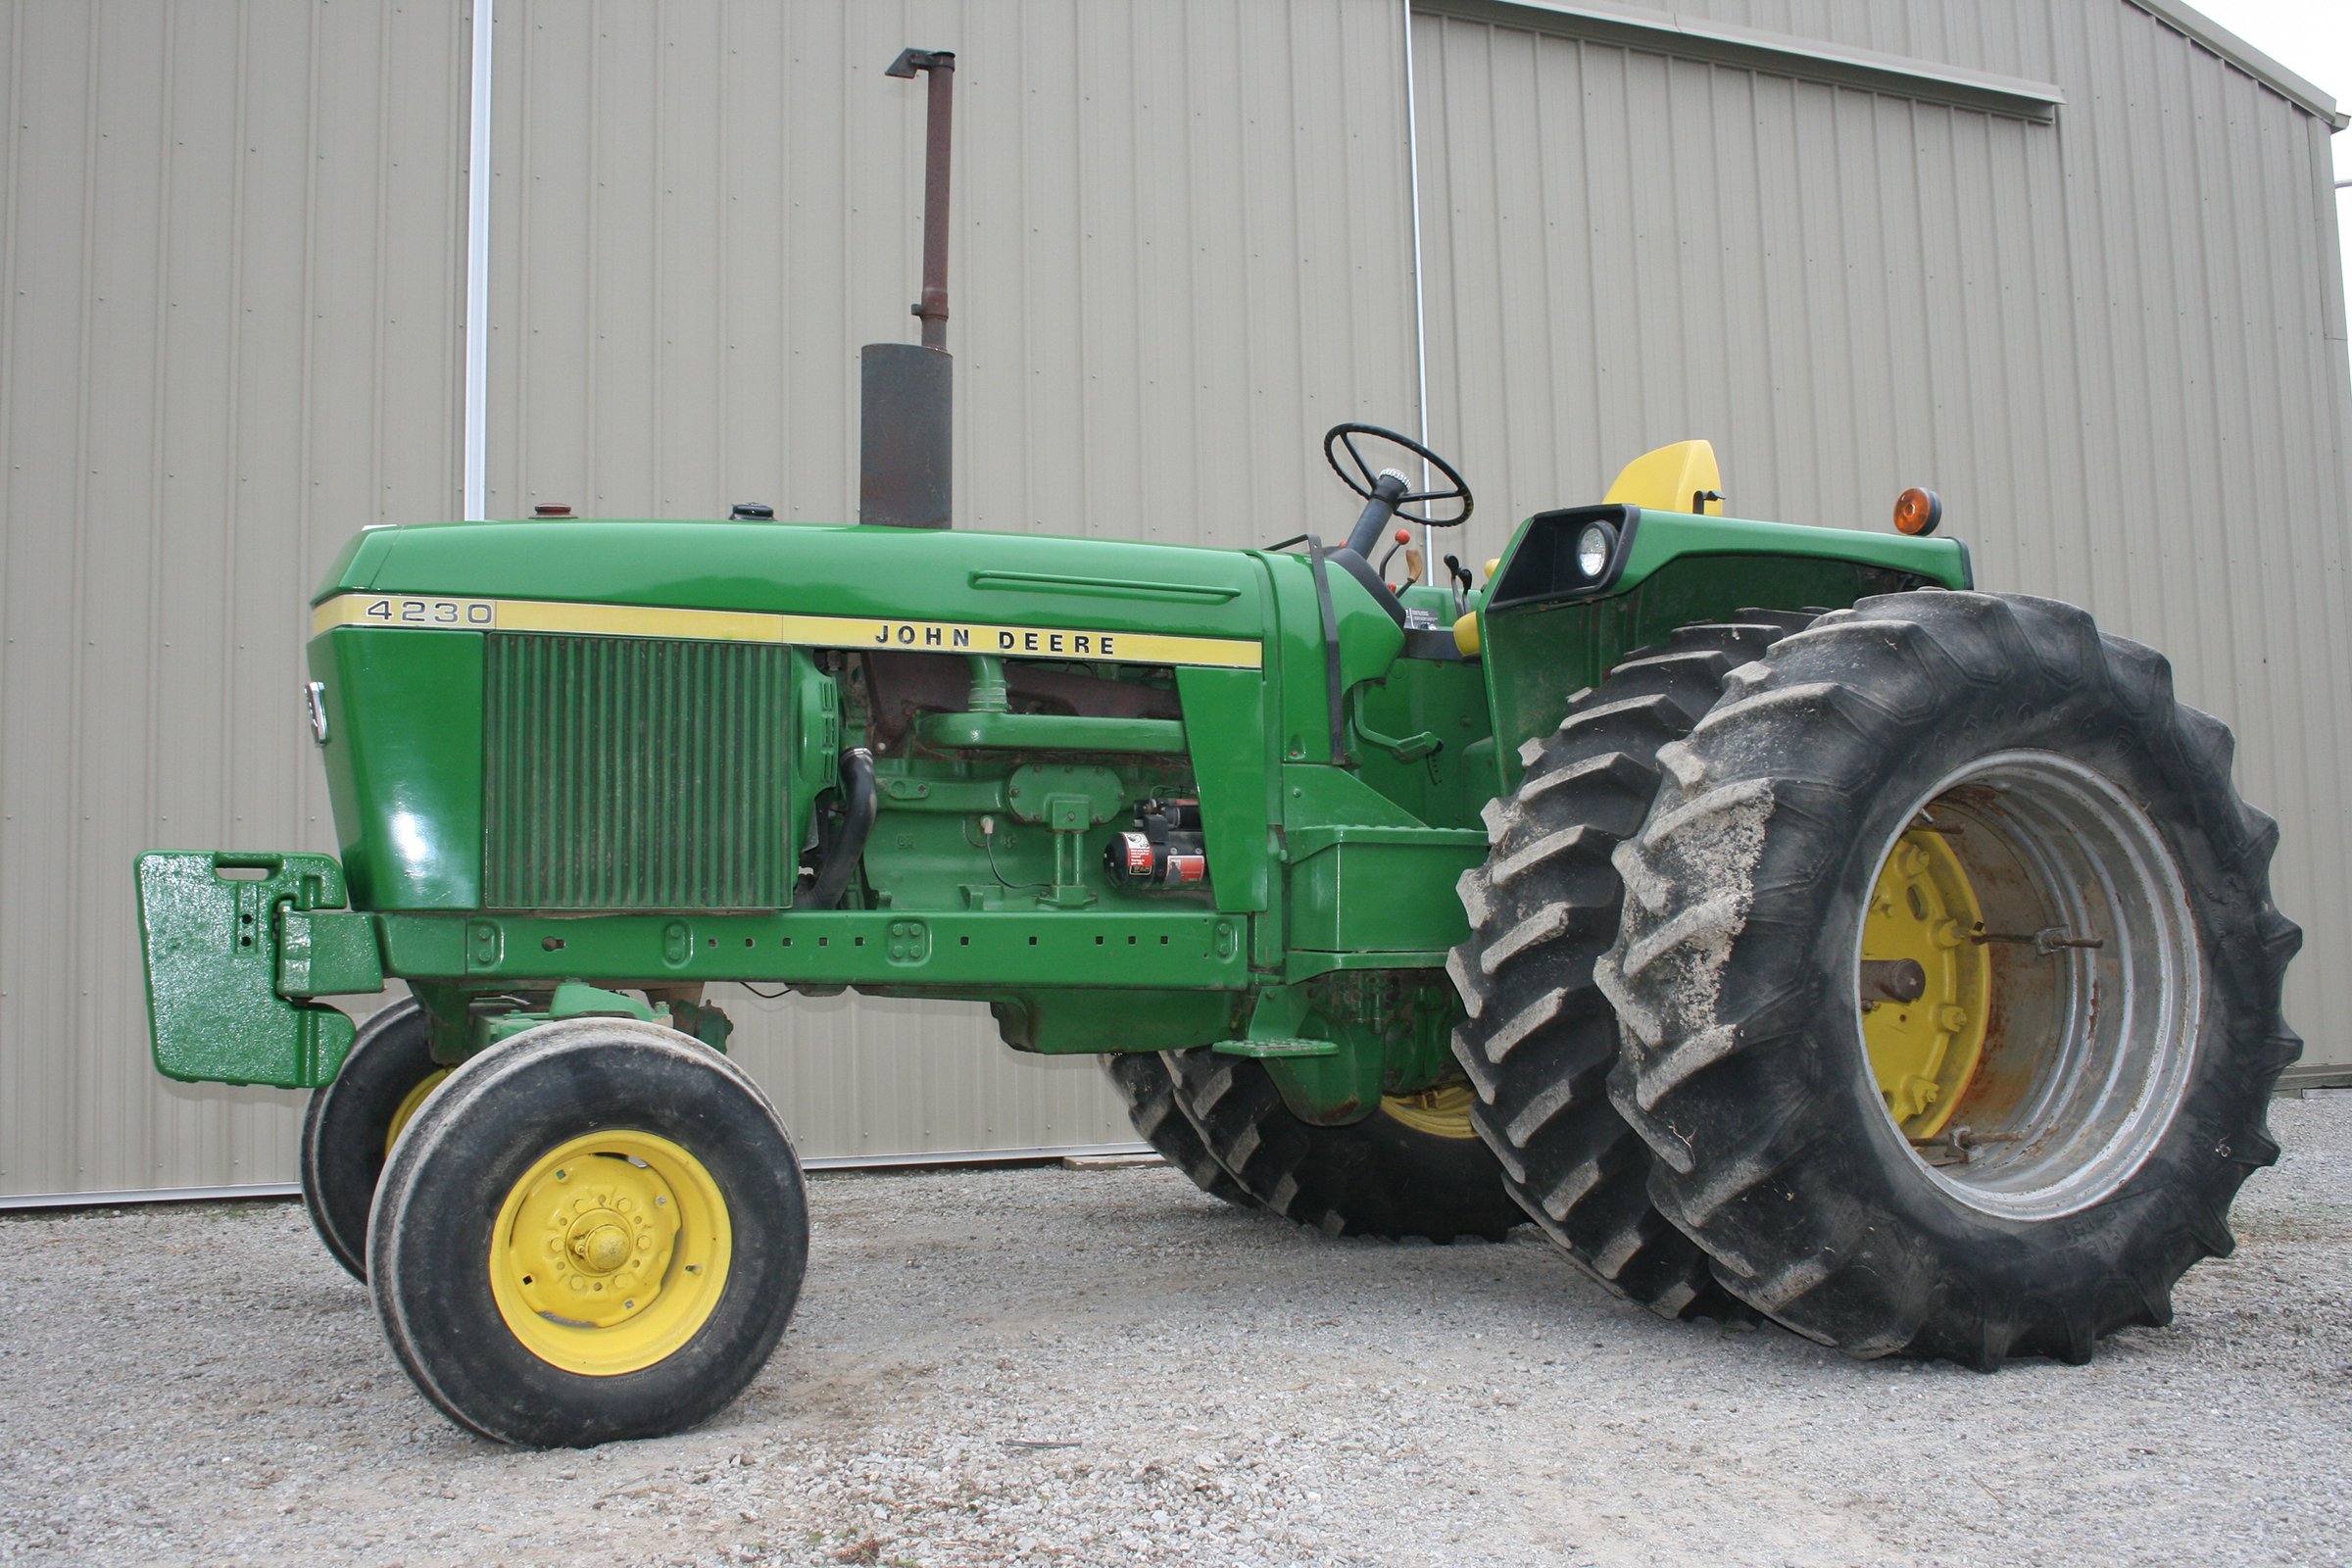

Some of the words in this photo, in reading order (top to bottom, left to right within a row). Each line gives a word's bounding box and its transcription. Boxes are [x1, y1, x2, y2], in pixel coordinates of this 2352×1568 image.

[367, 600, 493, 624] 4230
[875, 625, 969, 647] JOHN
[999, 631, 1114, 655] DEERE
